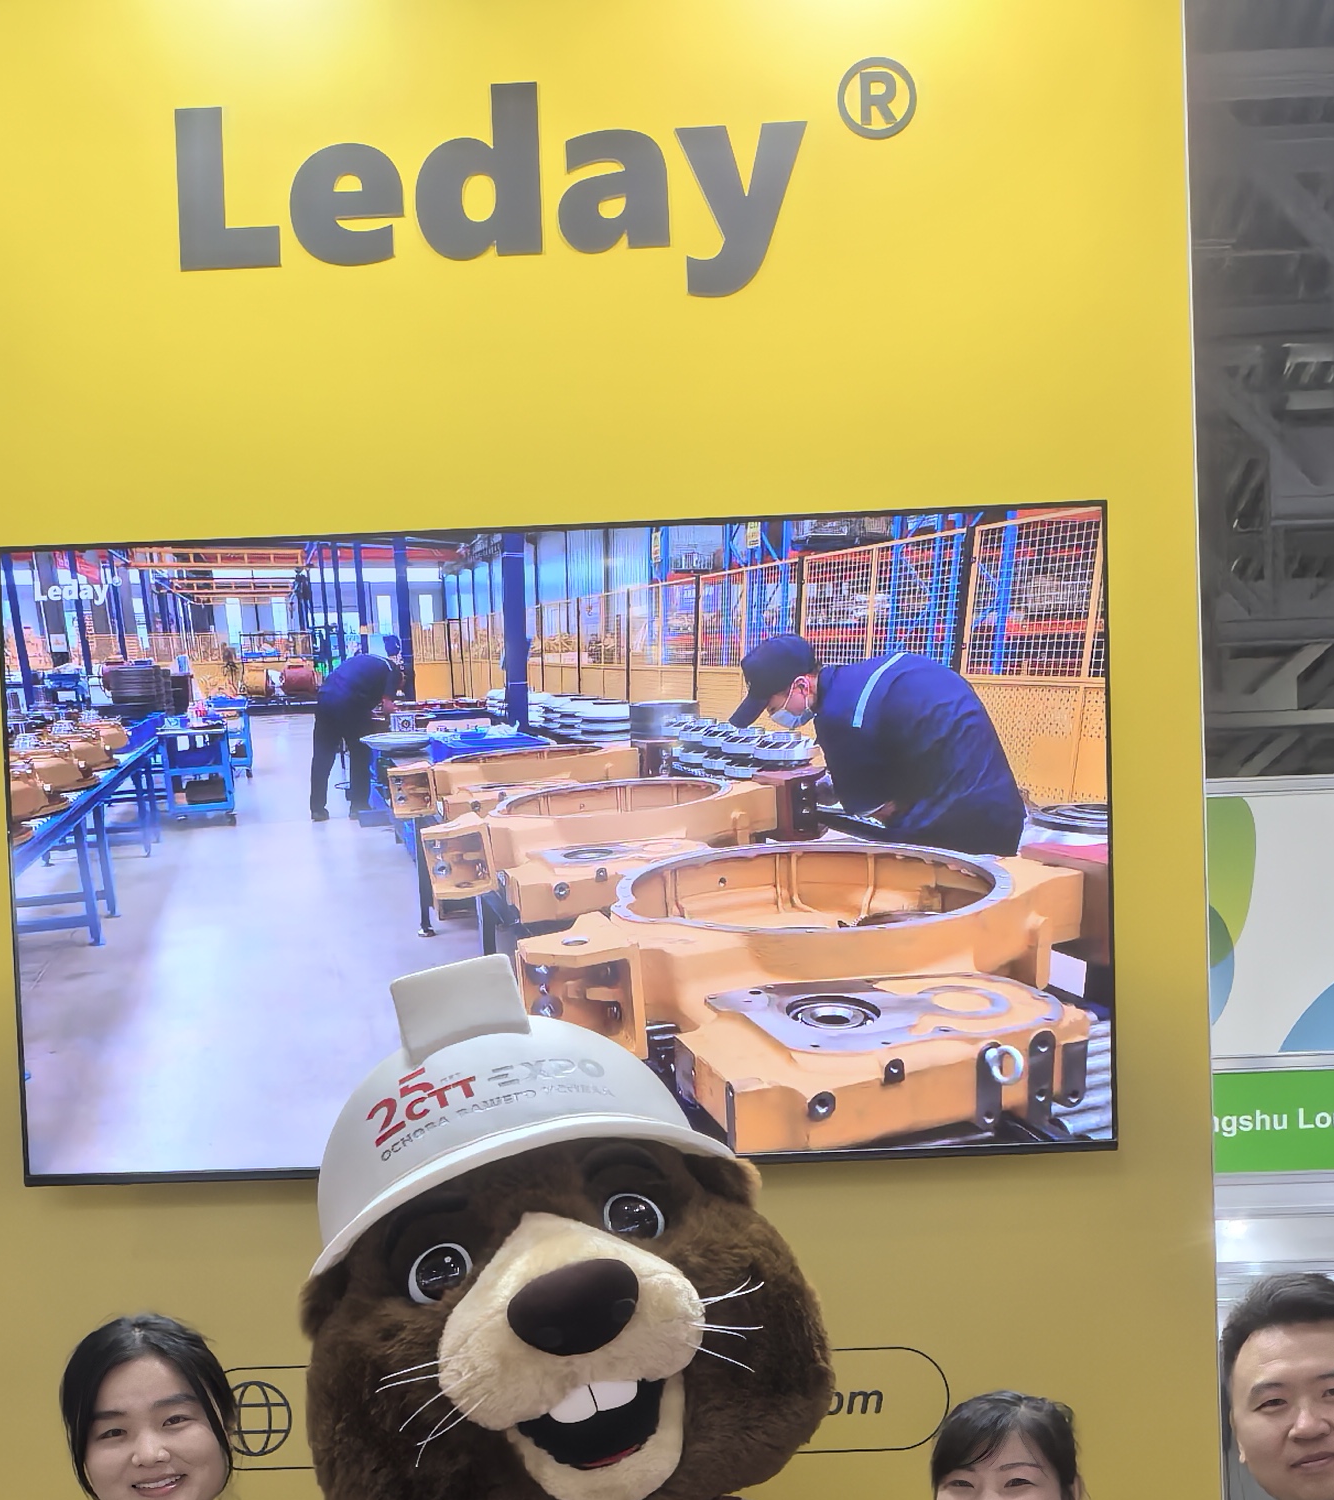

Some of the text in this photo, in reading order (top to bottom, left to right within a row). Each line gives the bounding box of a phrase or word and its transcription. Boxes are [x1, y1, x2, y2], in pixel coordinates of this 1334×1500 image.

[173, 82, 808, 298] Leday
[34, 578, 108, 606] Leday
[488, 1059, 605, 1087] EXPO
